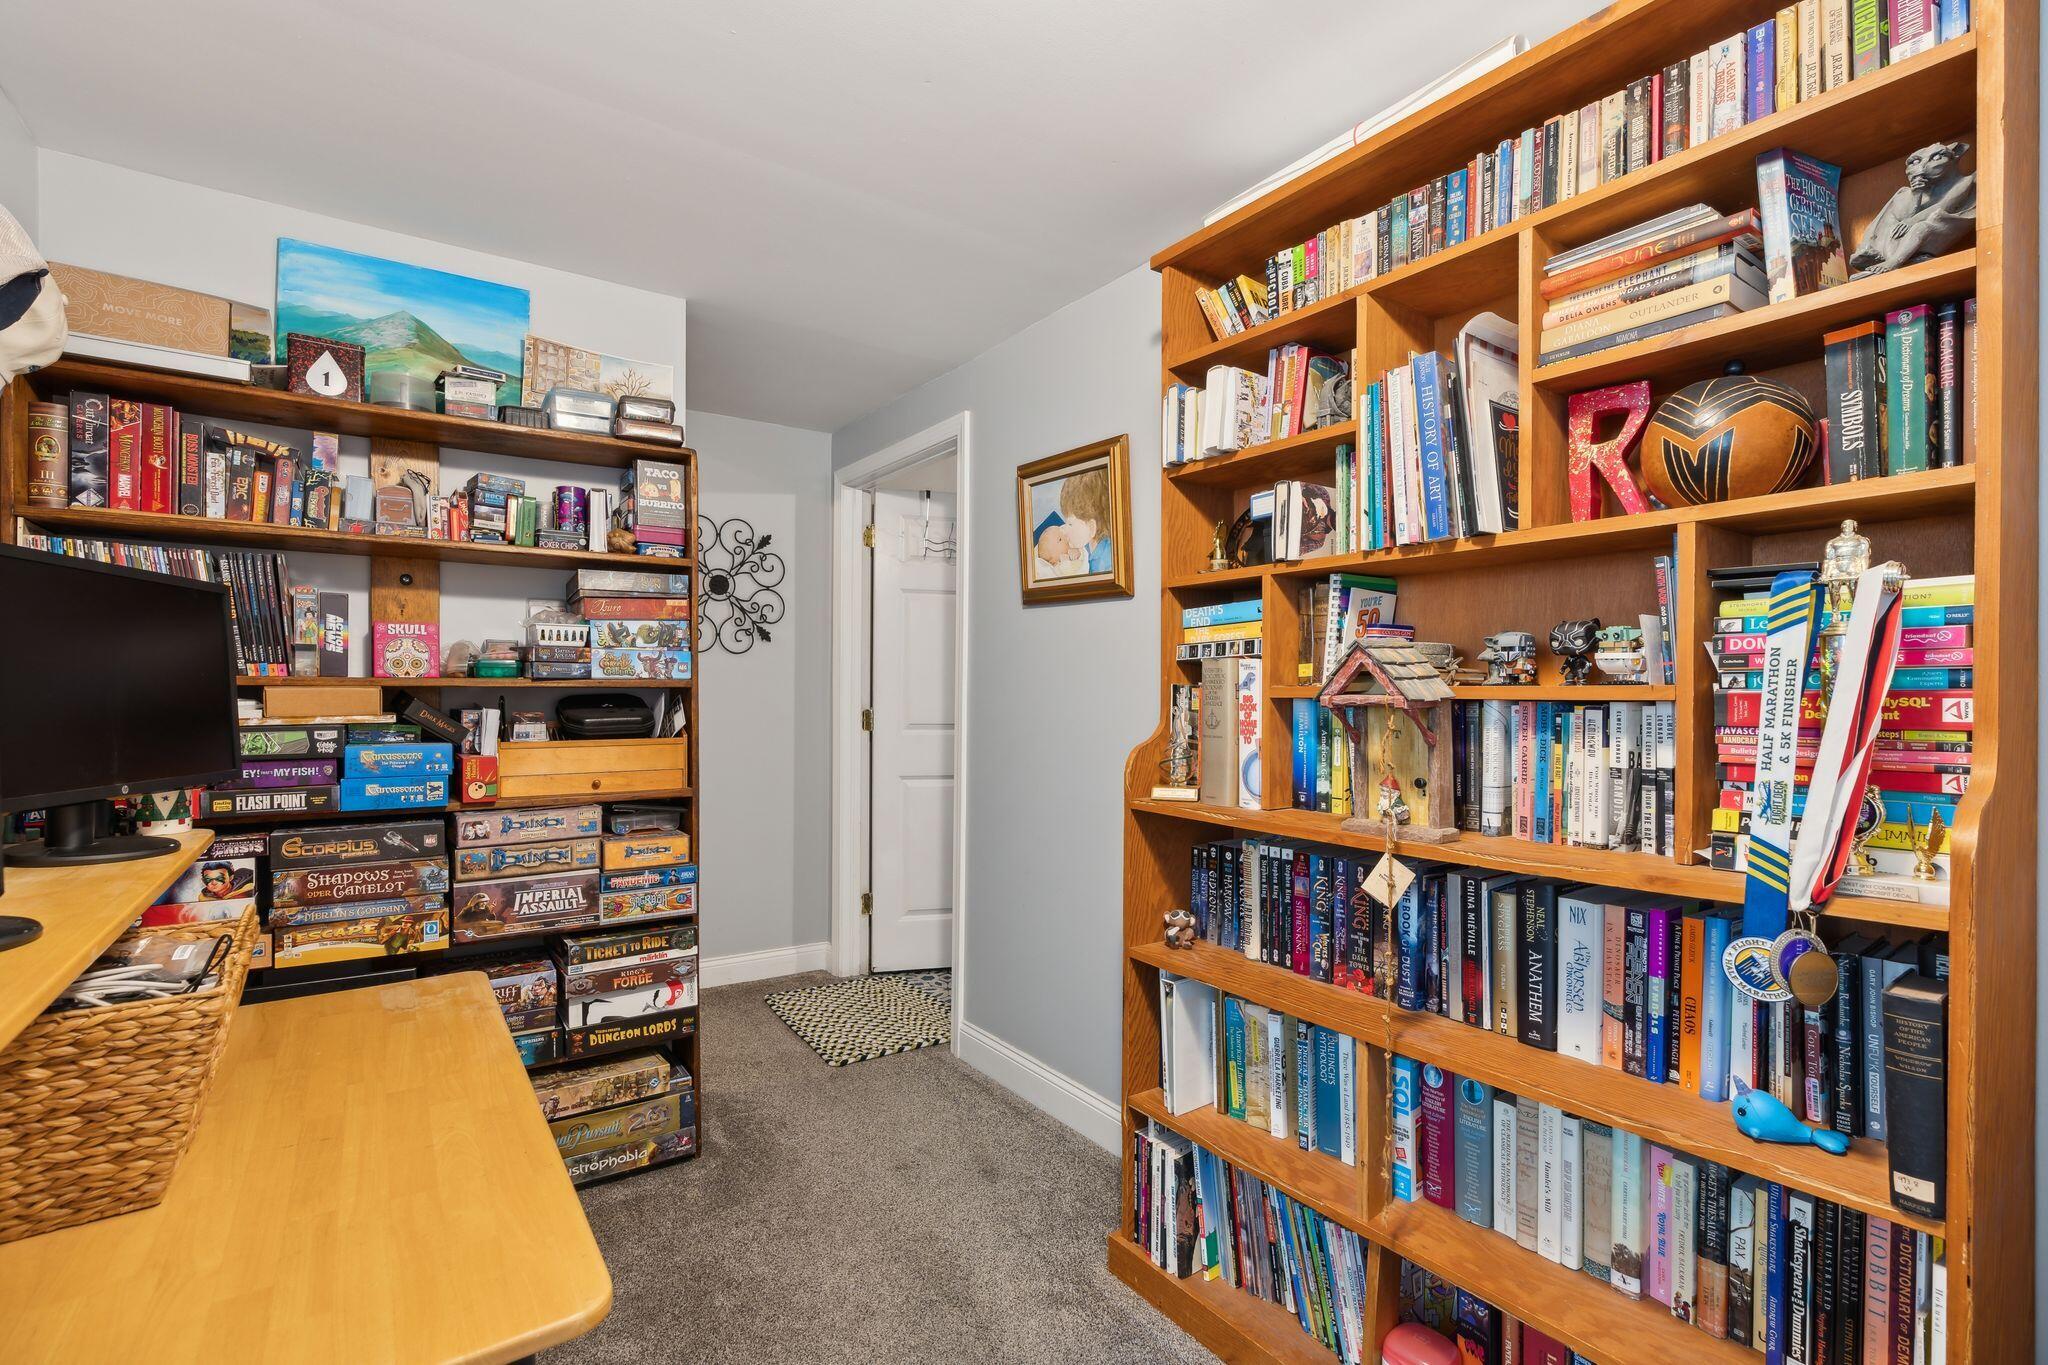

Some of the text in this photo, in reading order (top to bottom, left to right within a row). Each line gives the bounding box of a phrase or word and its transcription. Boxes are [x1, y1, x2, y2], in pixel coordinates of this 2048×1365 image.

[1801, 178, 1832, 207] HOUSE
[1618, 265, 1668, 289] ELEPHANT
[102, 302, 183, 327] MOVE MORE
[1559, 300, 1617, 322] DELIA OWENS
[1629, 293, 1700, 320] OUTLANDER
[1900, 336, 1913, 376] Dictionary
[1940, 320, 1954, 389] HAGAKURE
[1901, 384, 1913, 412] Dreams
[1841, 390, 1864, 451] SYMBOLS
[1422, 386, 1442, 502] HISTORY OF ART
[644, 467, 679, 480] TACO
[639, 499, 685, 511] BURRITO
[539, 540, 579, 551] POKER CHIPS
[1185, 604, 1224, 618] DEATH'S
[1190, 617, 1211, 627] END
[387, 624, 427, 635] SKULL
[1782, 658, 1798, 725] FINISHER
[1239, 703, 1258, 712] BOOK
[1760, 646, 1782, 771] HALF MARATHON
[1520, 705, 1529, 785] SISTER CARRIE
[1780, 732, 1792, 749] 5K
[242, 768, 260, 778] EY!
[274, 768, 290, 778] MY
[291, 766, 319, 776] FISH!
[236, 793, 306, 811] FLASH POINT
[307, 870, 390, 890] SHADOWS
[333, 881, 405, 898] CAMELOT
[1335, 875, 1346, 901] KING
[514, 887, 587, 909] IMPERIAL
[520, 899, 579, 915] ASSAULT
[1313, 875, 1329, 913] KING
[1467, 879, 1475, 910] CHINA
[1350, 887, 1370, 931] KING
[1402, 906, 1411, 938] BOOK
[1526, 888, 1535, 943] STEPHENSON
[1536, 906, 1545, 928] NEAL
[1569, 905, 1587, 925] NIX
[642, 936, 669, 950] RIDE
[1731, 939, 1767, 951] FLIGHT
[613, 973, 654, 989] FORGE
[1402, 956, 1411, 986] DUST
[1868, 969, 1876, 985] GARY
[1528, 950, 1543, 1024] ANATHEM
[1738, 982, 1790, 999] MARATHO
[1868, 986, 1876, 1003] JOHN
[1684, 996, 1697, 1036] CHAOS
[1869, 1004, 1877, 1028] BISHOP
[1896, 1018, 1929, 1029] HISTORY
[589, 1018, 677, 1046] DUNGEON LORDS
[1894, 1031, 1931, 1043] AMERICAN
[1273, 1036, 1281, 1072] GUERRILLA
[1319, 1031, 1327, 1084] MYTHOLOGY
[1838, 1044, 1851, 1082] Nicholas
[1392, 1073, 1410, 1120] SQL
[1836, 1084, 1852, 1111] Sparks
[1869, 1073, 1880, 1114] YOURSELF
[1543, 1160, 1551, 1197] Hamlet's
[1658, 1237, 1666, 1257] BLUE
[1735, 1235, 1746, 1260] PAX
[1769, 1222, 1779, 1274] SHAKESPEARE
[1868, 1223, 1889, 1324] HOBBIT
[1898, 1245, 1912, 1324] DICTIONARY
[1791, 1225, 1808, 1362] Shakespeare Dummies
[1768, 1295, 1778, 1326] ANDREW
